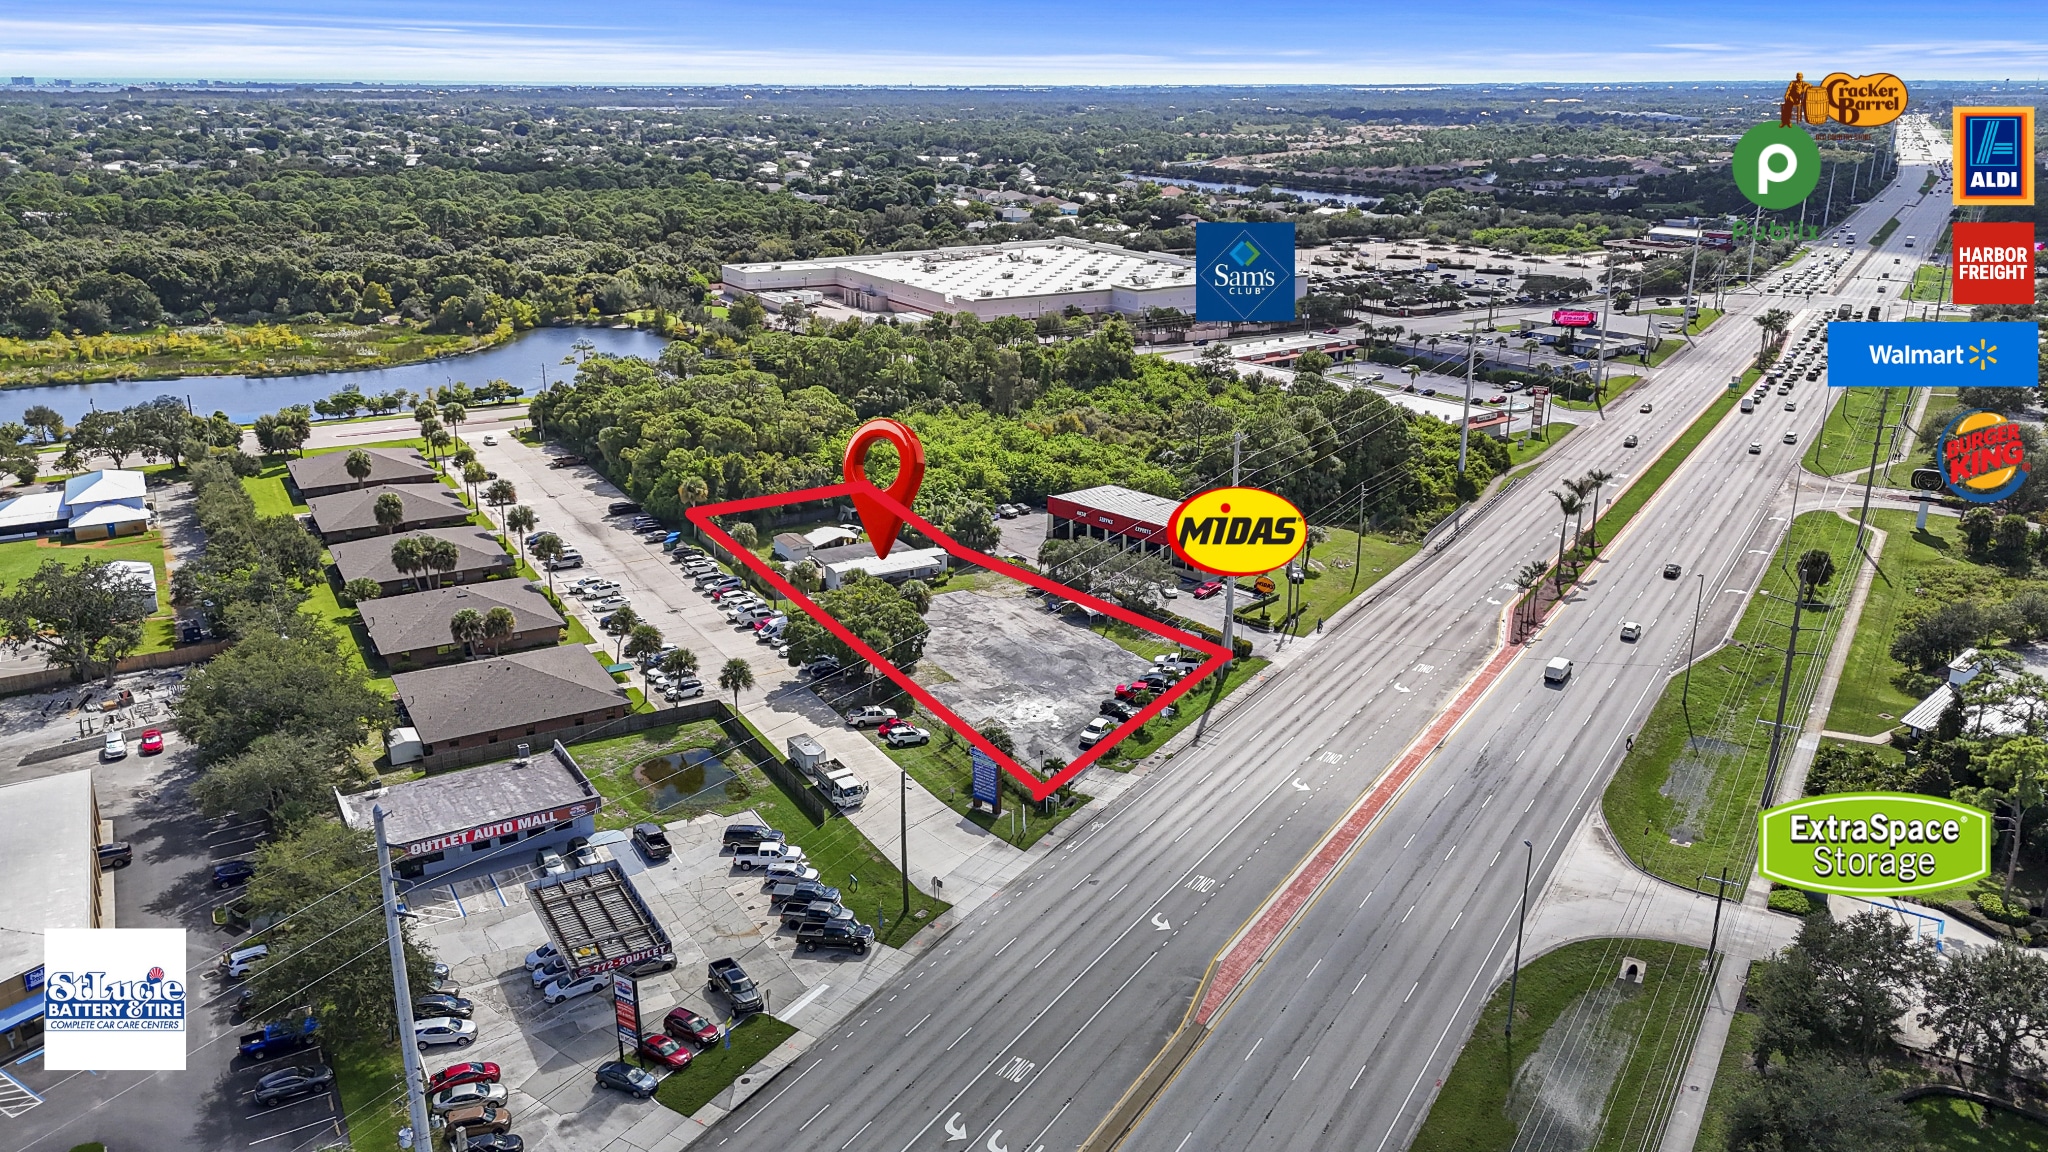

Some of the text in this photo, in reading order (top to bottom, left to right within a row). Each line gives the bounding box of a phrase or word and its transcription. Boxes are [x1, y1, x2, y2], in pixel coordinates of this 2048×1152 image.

[1412, 663, 1435, 674] ONLY
[1316, 750, 1343, 765] ONLY
[410, 811, 558, 855] OUTLET AUTO MALL
[1184, 875, 1216, 893] ONLY
[995, 1055, 1036, 1083] ONLY
